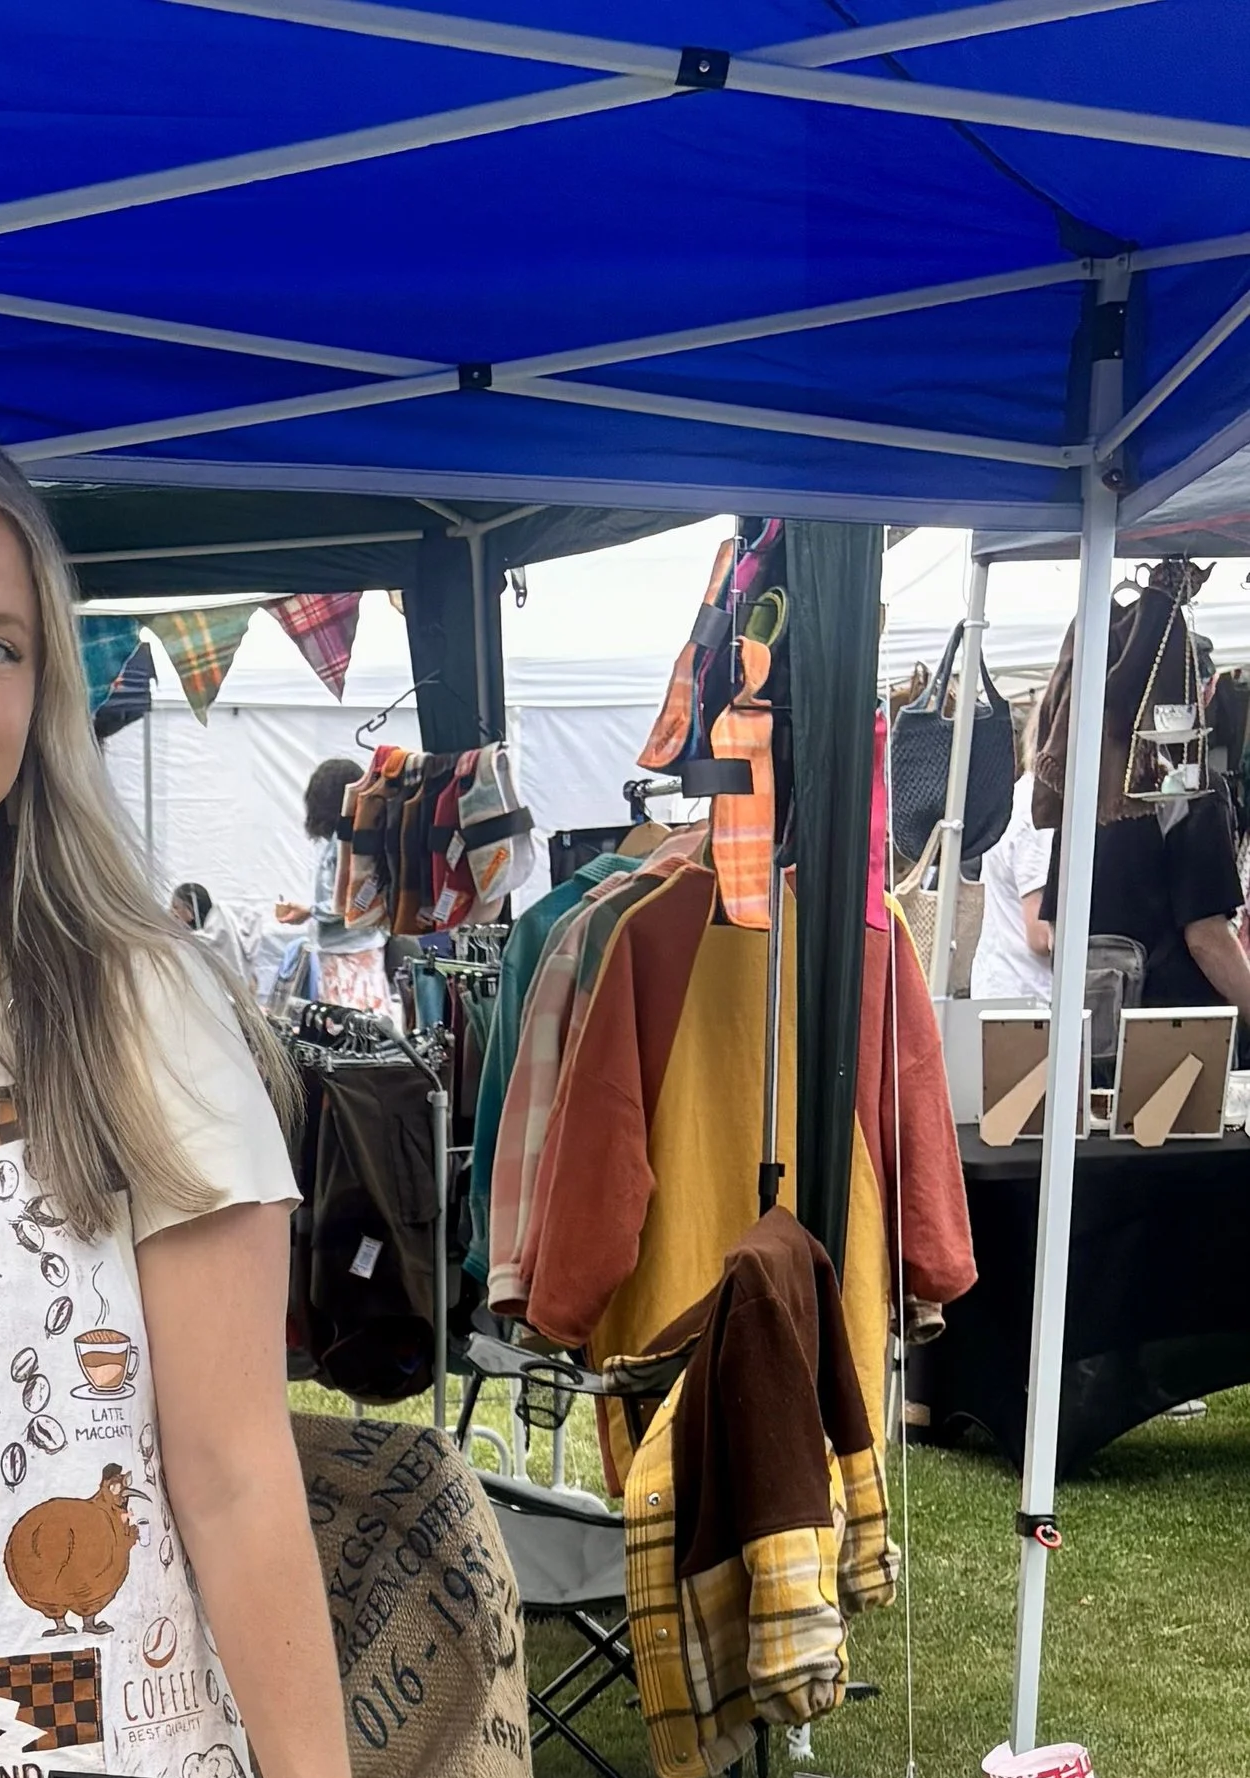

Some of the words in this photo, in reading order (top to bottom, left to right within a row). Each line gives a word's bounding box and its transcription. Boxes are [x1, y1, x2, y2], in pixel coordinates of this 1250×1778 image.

[92, 1407, 125, 1422] LATTE
[124, 1670, 200, 1722] COFFEE
[128, 1726, 162, 1743] BEST
